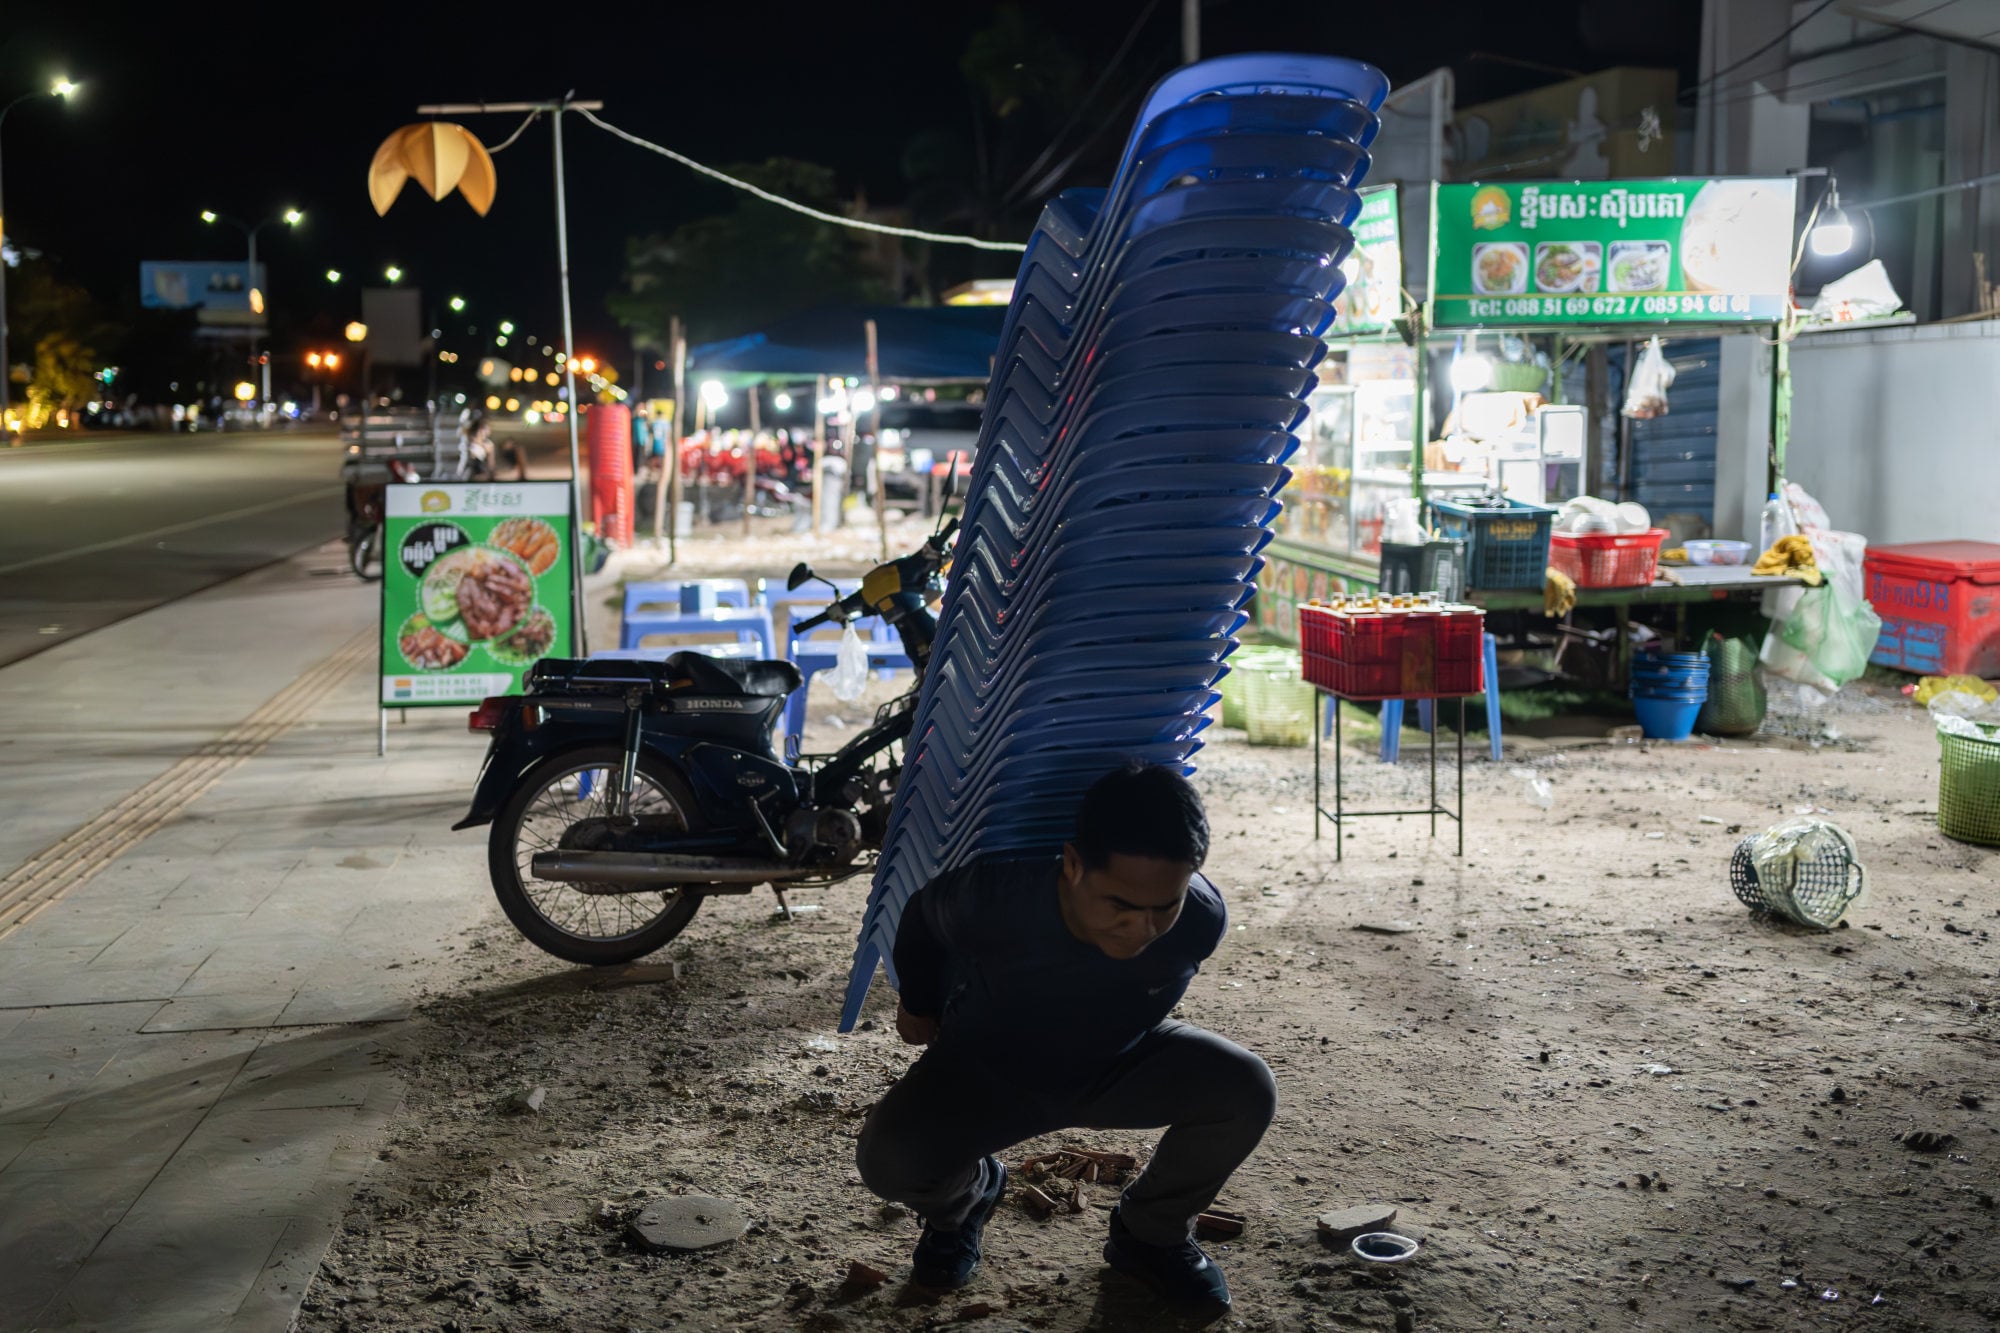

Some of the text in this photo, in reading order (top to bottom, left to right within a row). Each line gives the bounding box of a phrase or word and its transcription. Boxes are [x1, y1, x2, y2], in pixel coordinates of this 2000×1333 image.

[1469, 298, 1502, 317] Tel:
[1505, 298, 1539, 316] 088
[1543, 297, 1562, 316] 51
[1565, 297, 1589, 315] 69
[1592, 297, 1626, 315] 672
[1643, 295, 1677, 314] 085
[1681, 295, 1704, 313] 94
[687, 699, 744, 710] HONDA
